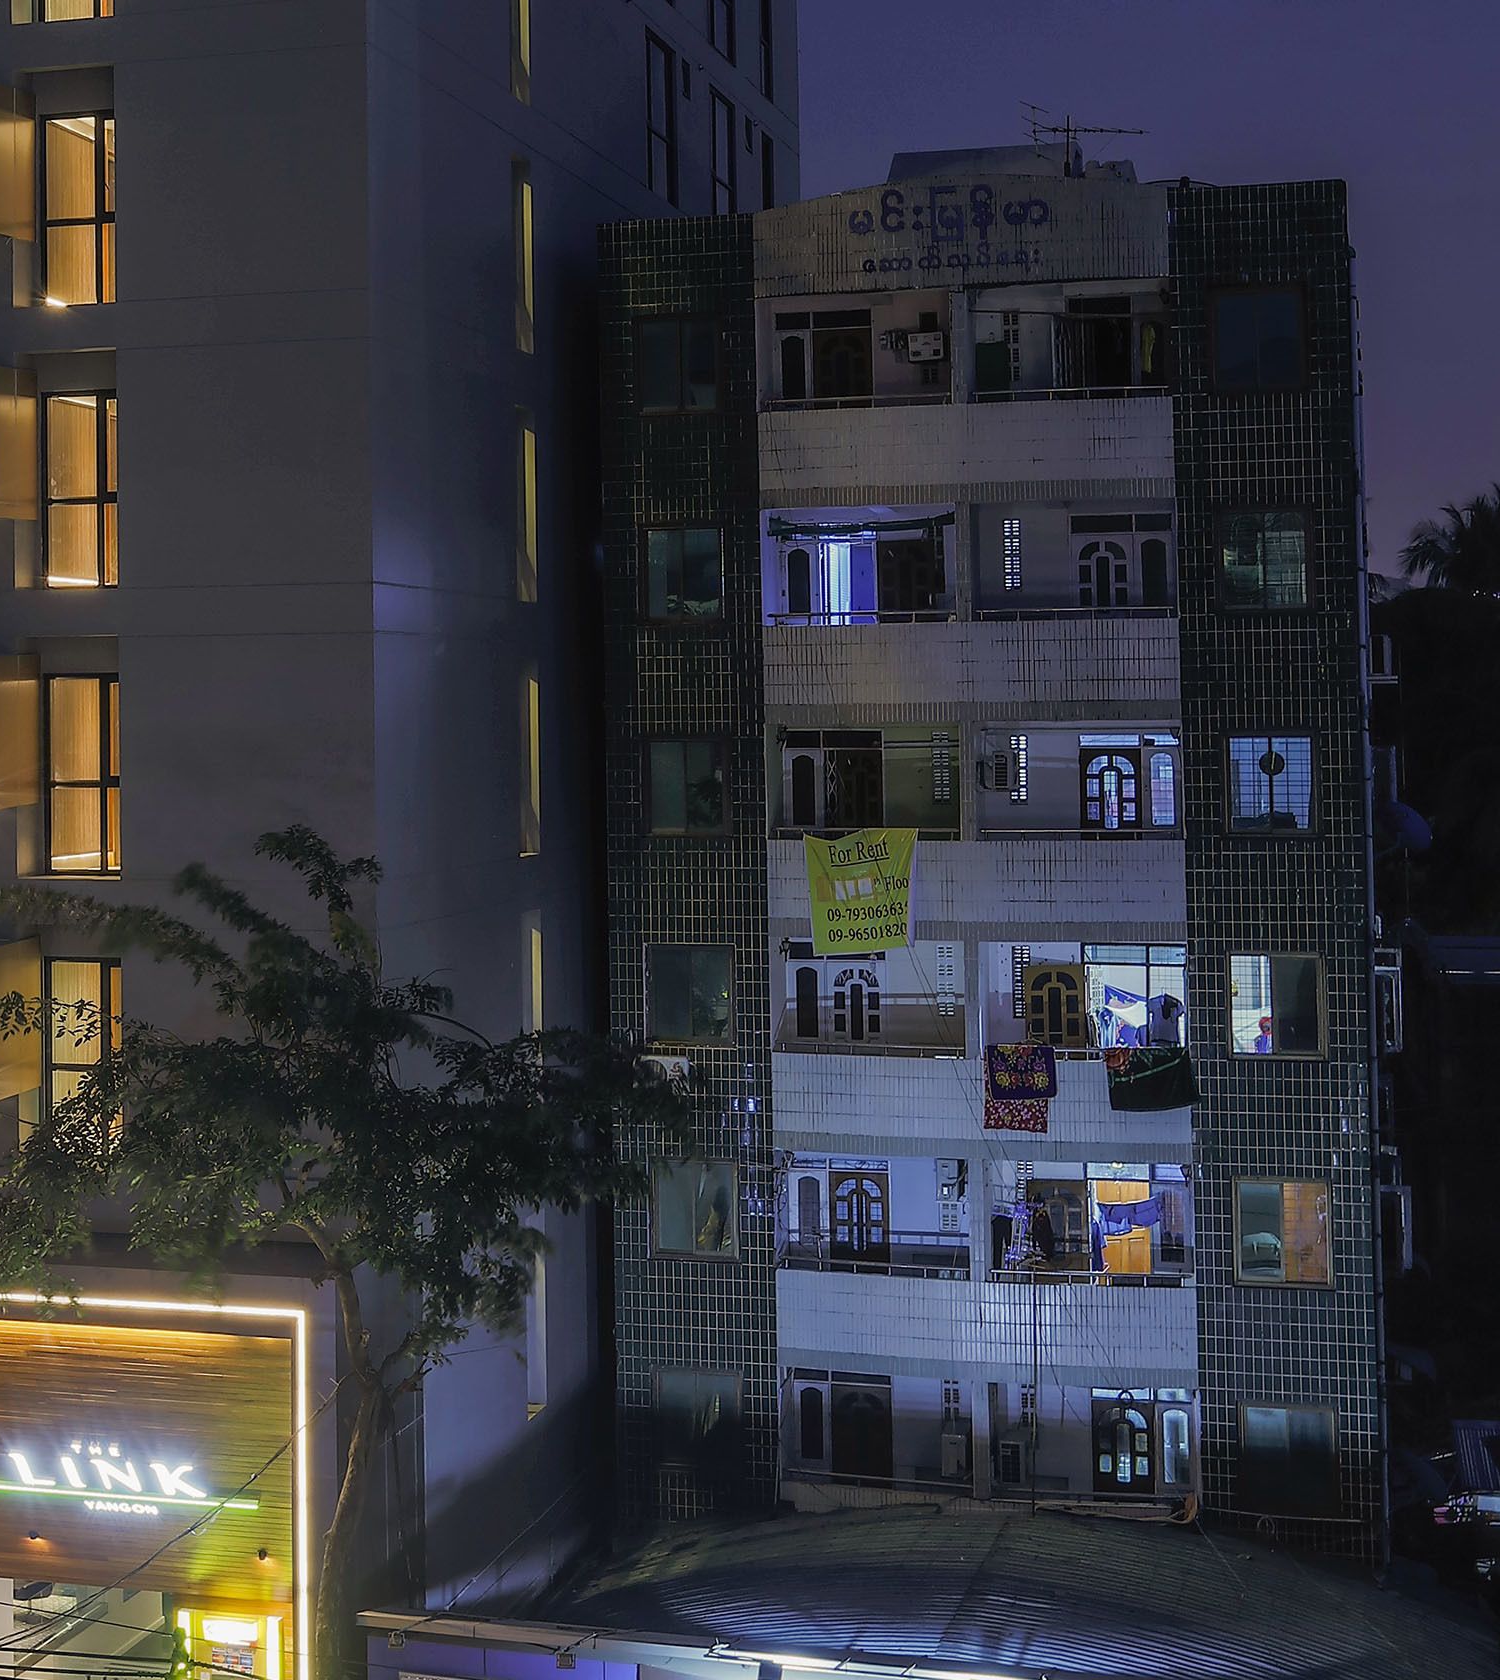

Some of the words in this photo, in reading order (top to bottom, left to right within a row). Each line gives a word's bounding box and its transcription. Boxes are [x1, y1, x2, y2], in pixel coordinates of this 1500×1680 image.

[828, 845, 852, 864] For
[855, 839, 889, 860] Rent
[69, 1441, 121, 1457] THE
[8, 1450, 207, 1498] LINK
[83, 1500, 159, 1515] YANGON
